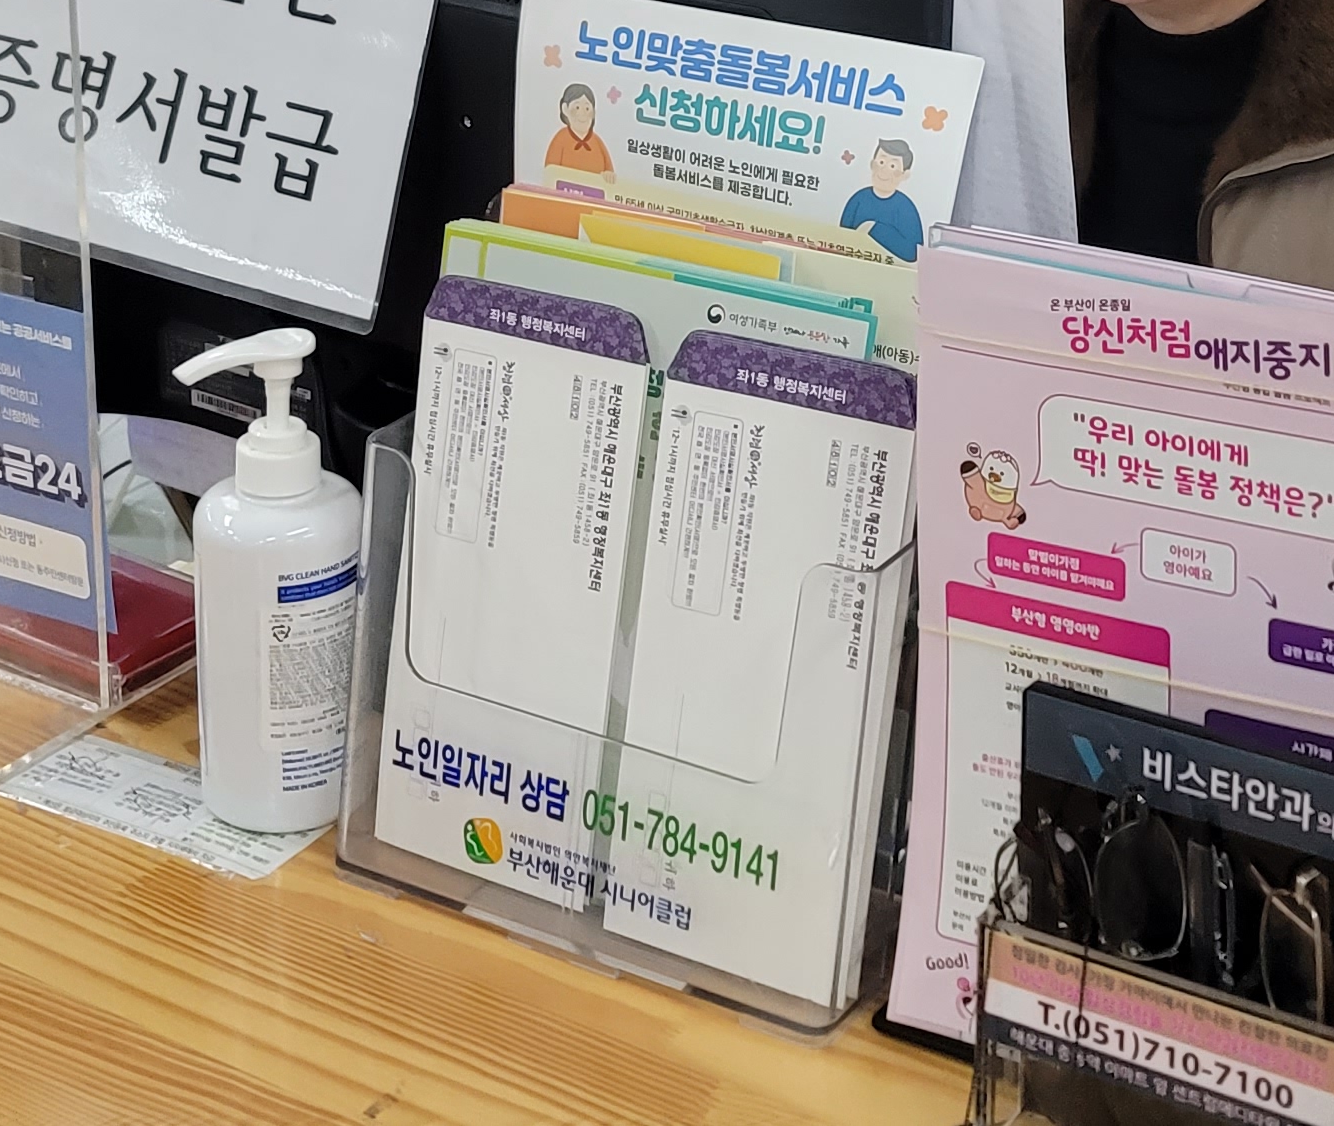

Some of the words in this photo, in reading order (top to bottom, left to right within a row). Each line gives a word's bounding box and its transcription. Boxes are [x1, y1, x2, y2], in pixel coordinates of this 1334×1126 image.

[573, 20, 907, 118] 노인맞춤돌봄서비스
[633, 85, 828, 156] 신청하세요!
[626, 138, 687, 165] 일상생활이
[689, 152, 726, 173] 어려운
[728, 158, 778, 183] 노인에게
[781, 170, 821, 192] 필요한
[653, 163, 725, 192] 돌봄서비스를
[727, 180, 794, 207] 제공합니다.
[489, 307, 518, 326] 좌1동
[521, 314, 586, 341] 행정복지센터
[1050, 298, 1060, 311] 온
[1063, 298, 1096, 312] 부산이
[1098, 298, 1131, 312] 온종일
[13, 323, 72, 351] 공공서비스를
[1062, 315, 1192, 360] 당신처럼
[1194, 337, 1331, 381] 애지중지
[736, 368, 770, 388] 좌1동
[773, 376, 848, 405] 행정복지센터
[2, 405, 41, 427] 신청하는
[608, 383, 624, 440] 부산광역시
[1073, 412, 1134, 446] "우리
[1144, 429, 1249, 467] 아이에게
[601, 442, 618, 488] 해운대구
[872, 449, 889, 509] 부산광역시
[1073, 448, 1107, 477] 딱!
[1117, 455, 1165, 489] 맞는
[1174, 466, 1219, 500] 돌봄
[597, 490, 612, 522] 좌1동
[588, 524, 608, 592] 행정복지센터
[864, 511, 882, 560] 해운대구
[1169, 544, 1207, 564] 아이가
[295, 569, 320, 581] CLEAN
[321, 562, 340, 576] HAND
[1163, 560, 1213, 582] 영아예요
[1011, 605, 1046, 628] 부산형
[392, 728, 513, 805] 노인일자리
[519, 769, 571, 823] 상담
[582, 788, 780, 891] 051-784-9141
[506, 847, 595, 899] 부산해운대
[599, 877, 693, 931] 시니어클럽
[926, 952, 970, 971] Good!
[1037, 999, 1295, 1110] T.(051)710-7100
